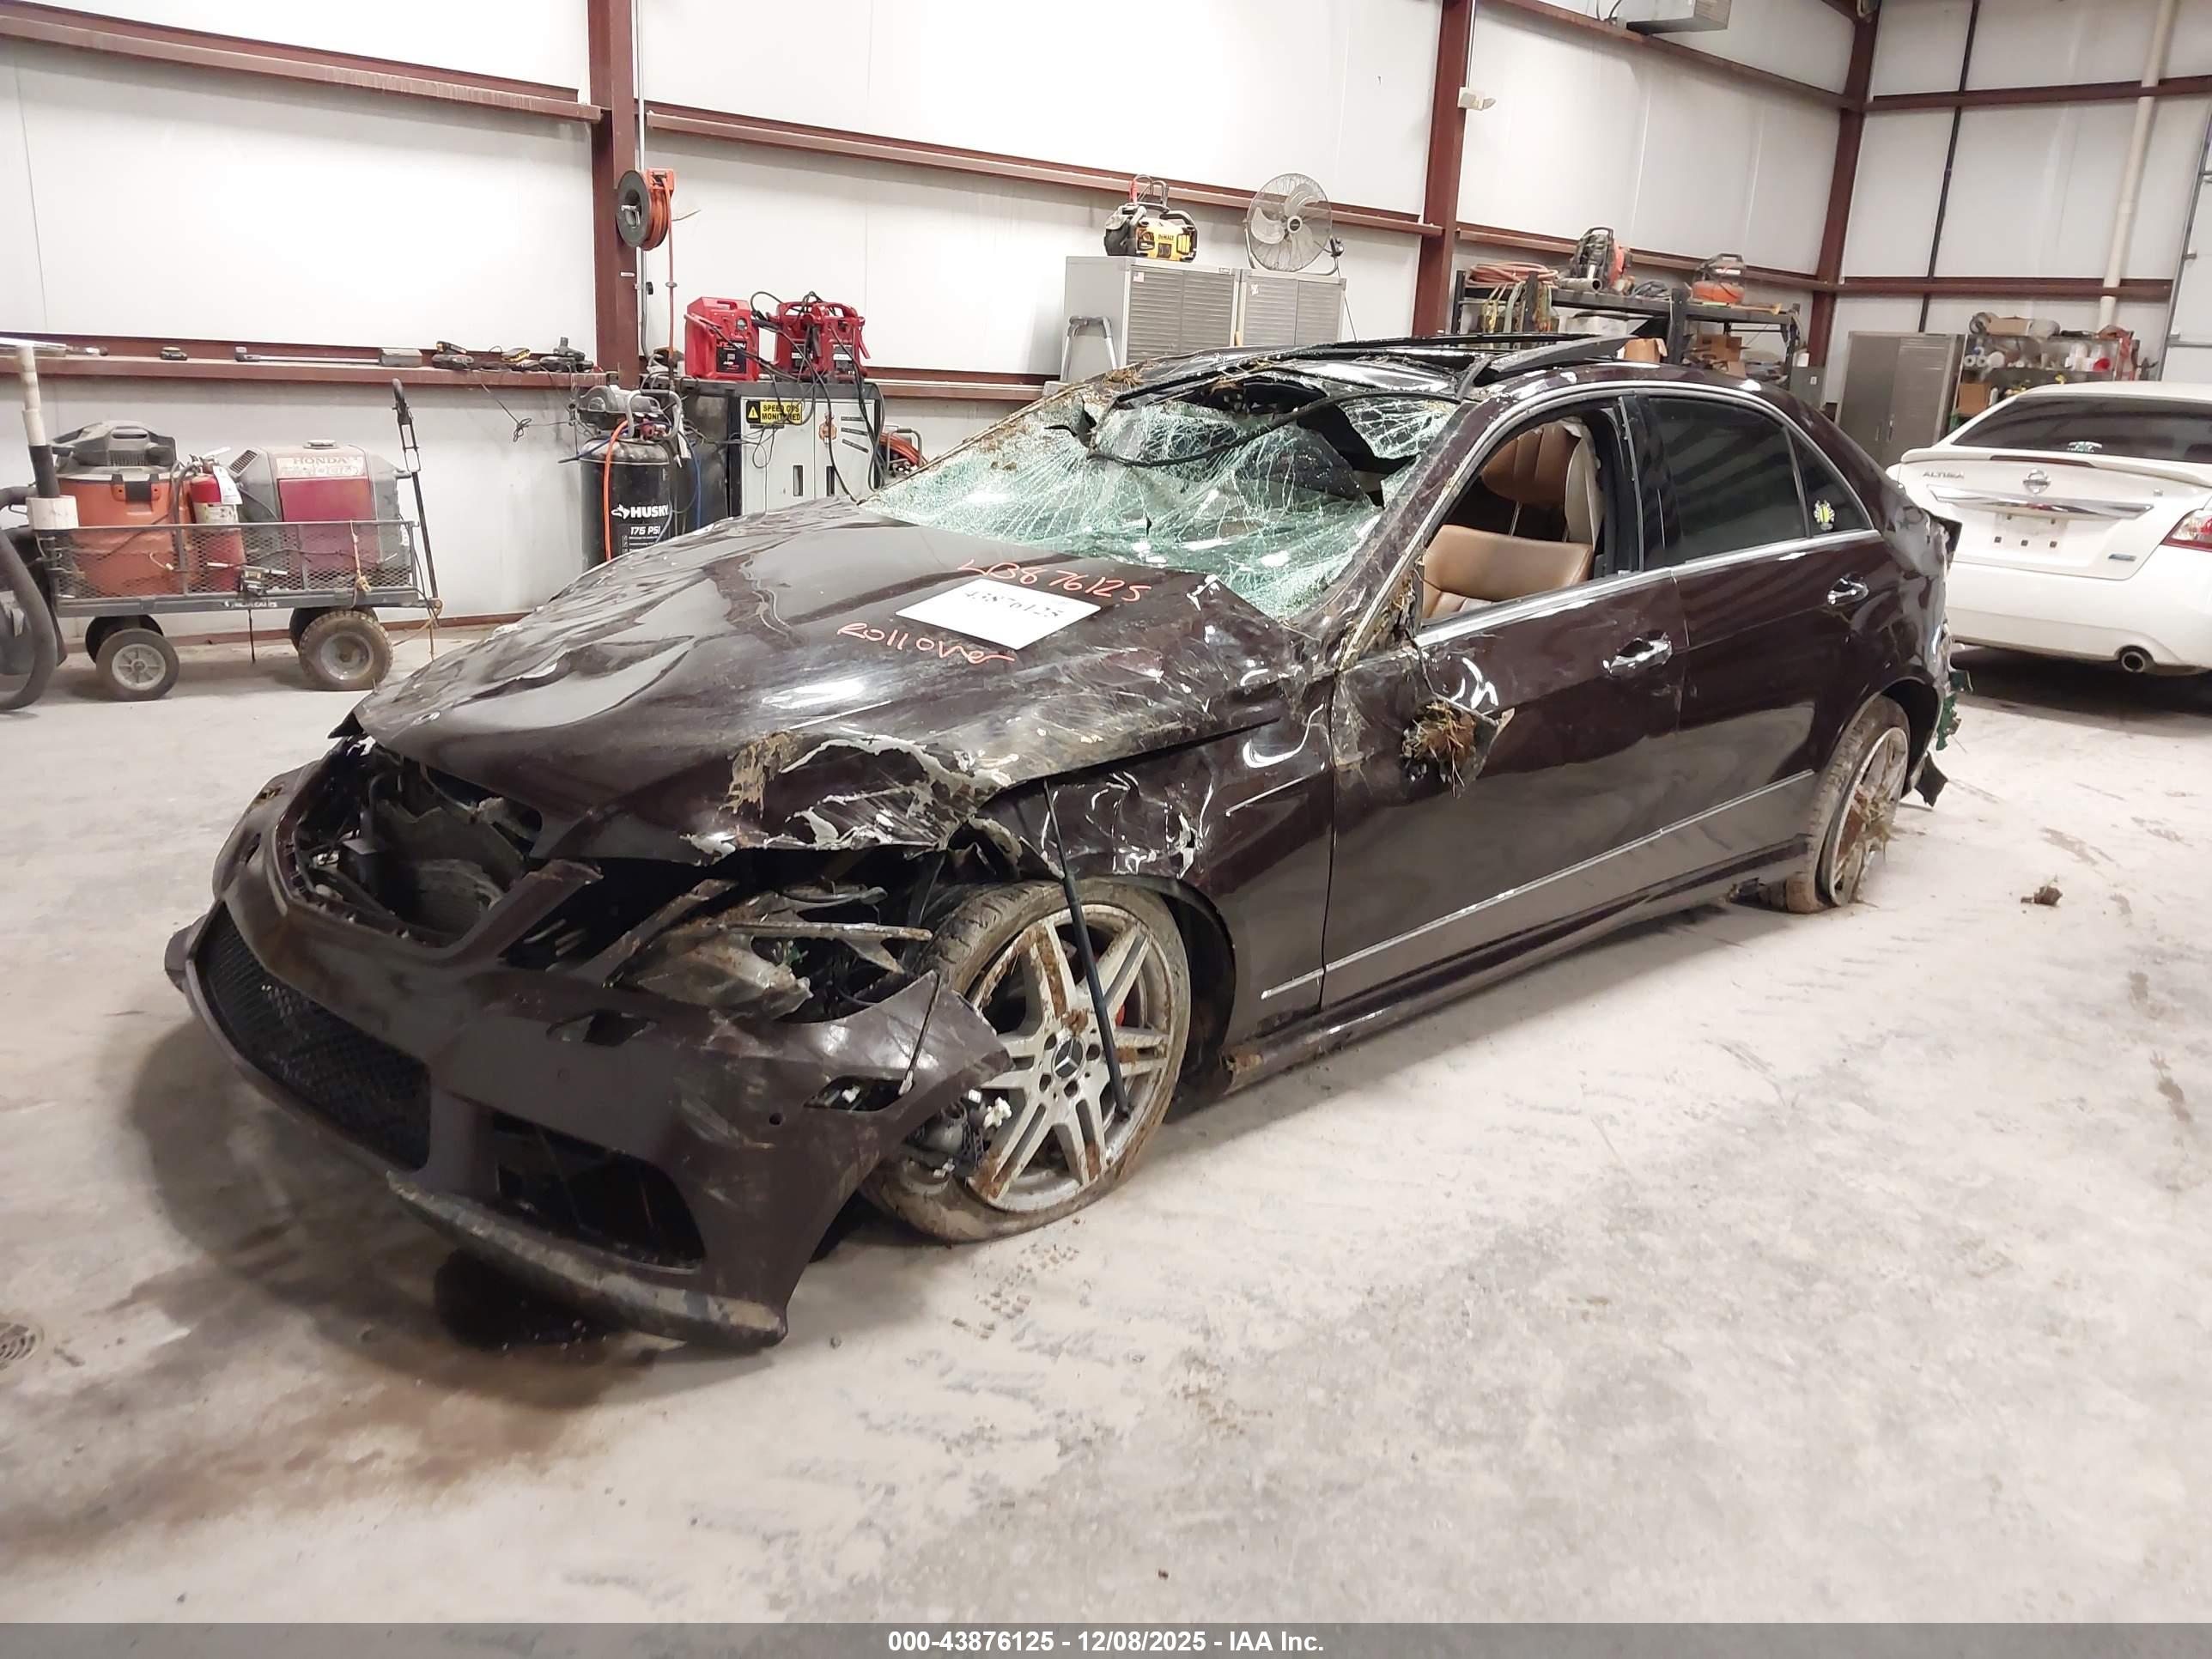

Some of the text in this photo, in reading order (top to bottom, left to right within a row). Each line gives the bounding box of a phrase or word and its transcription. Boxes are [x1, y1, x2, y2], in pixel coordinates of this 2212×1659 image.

[762, 412, 801, 421] MONITED
[630, 504, 669, 519] HUSKY
[647, 525, 661, 536] PSI
